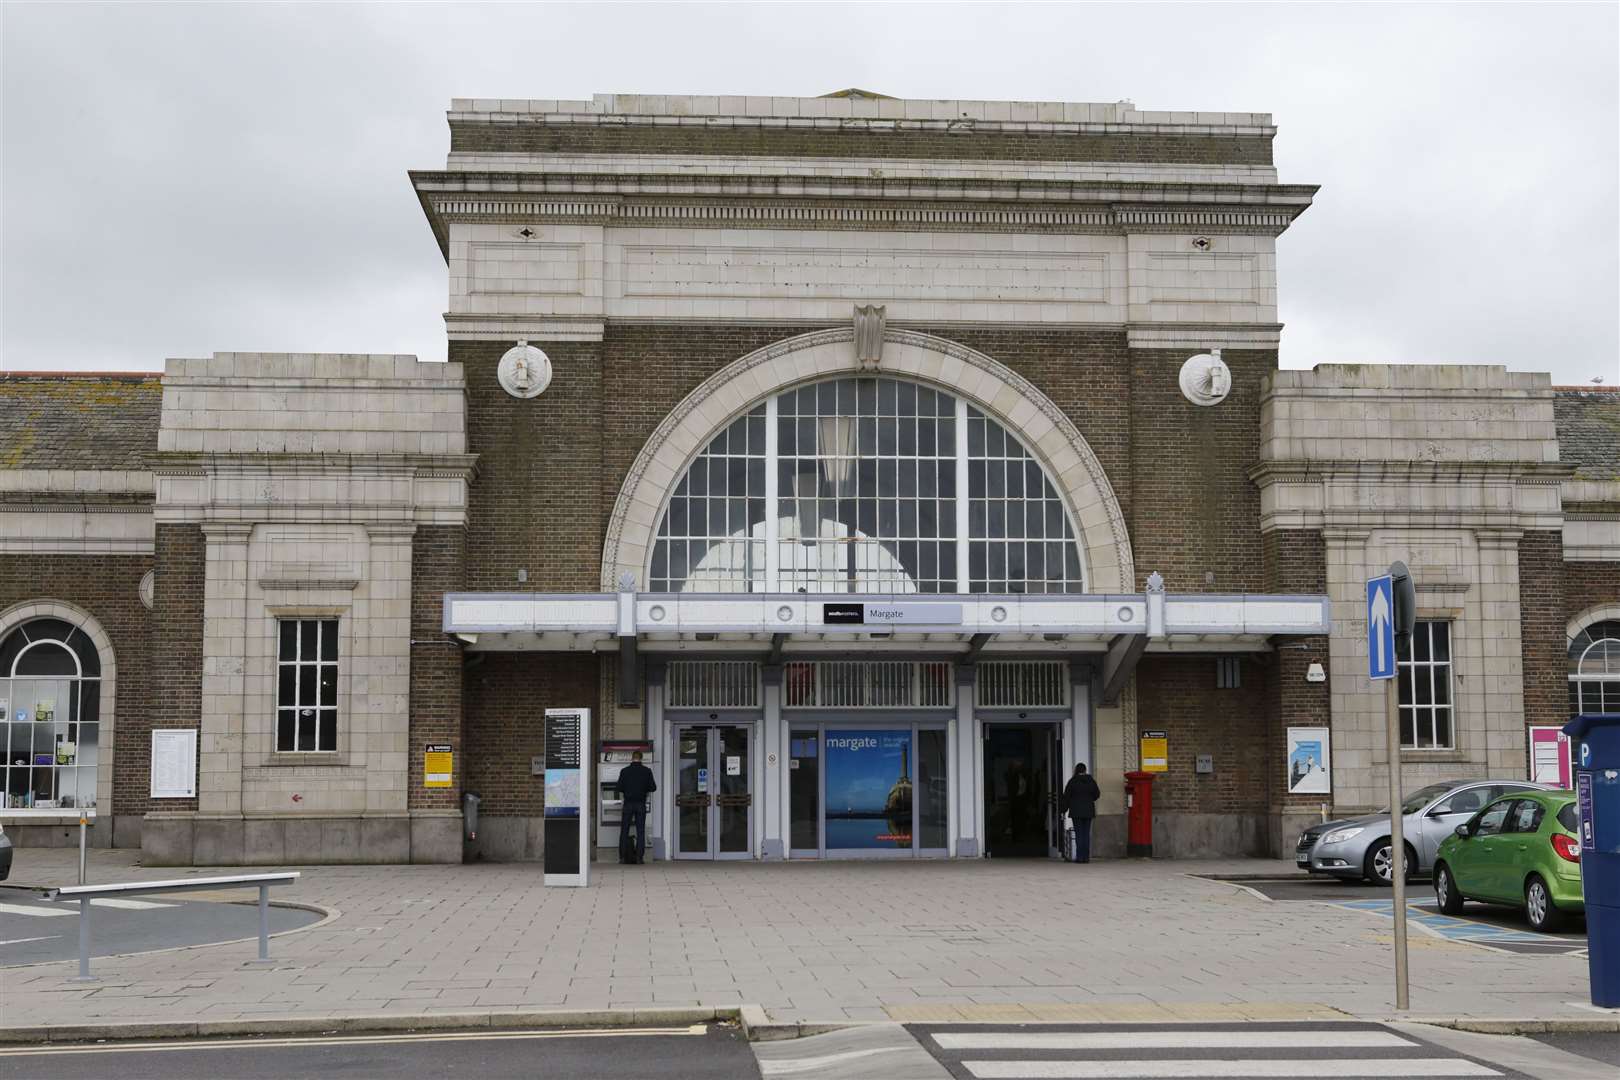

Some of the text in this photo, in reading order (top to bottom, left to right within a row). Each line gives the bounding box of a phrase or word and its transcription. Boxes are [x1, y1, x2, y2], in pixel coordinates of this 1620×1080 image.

[870, 609, 903, 620] Margate
[826, 736, 877, 751] margate
[1581, 743, 1589, 766] P
